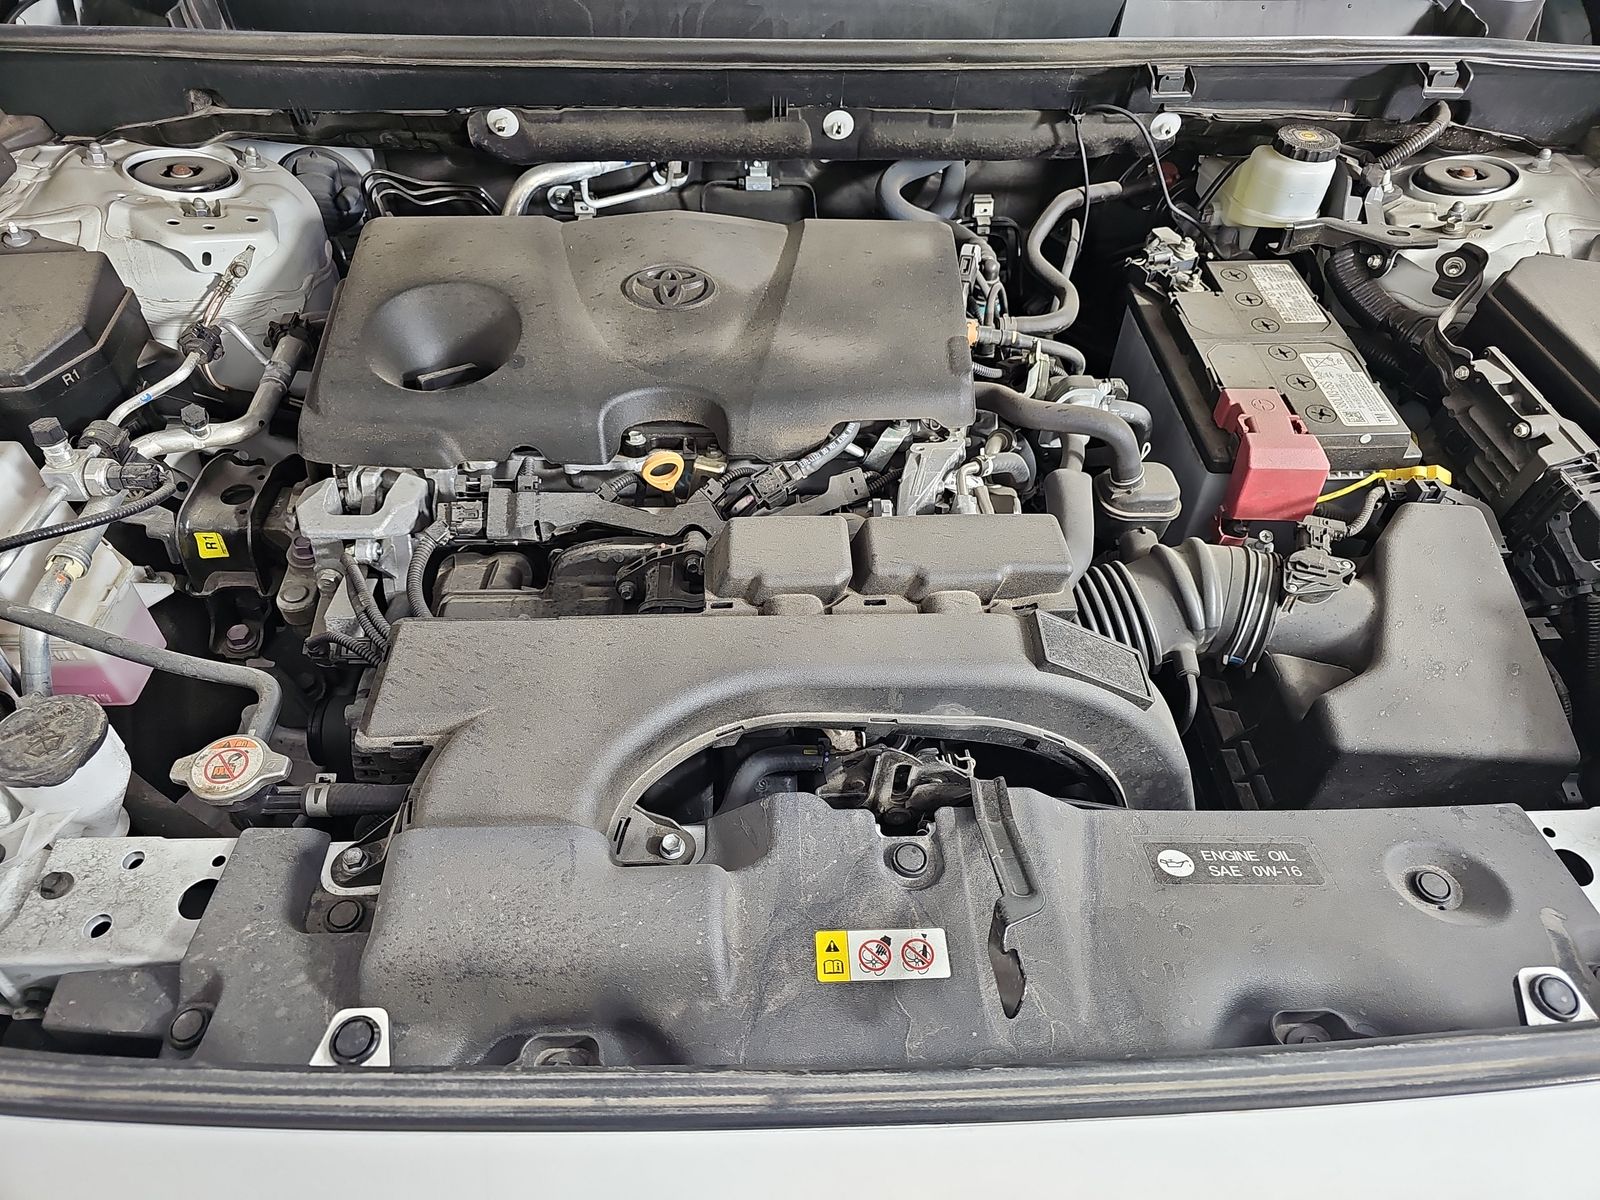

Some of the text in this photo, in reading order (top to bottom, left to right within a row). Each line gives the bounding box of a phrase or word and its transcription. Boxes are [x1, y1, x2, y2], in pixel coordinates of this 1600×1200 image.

[61, 368, 81, 386] R1
[202, 536, 218, 549] R1
[1200, 850, 1296, 862] ENGINE OIL
[1208, 865, 1303, 877] SAE 0W-16
